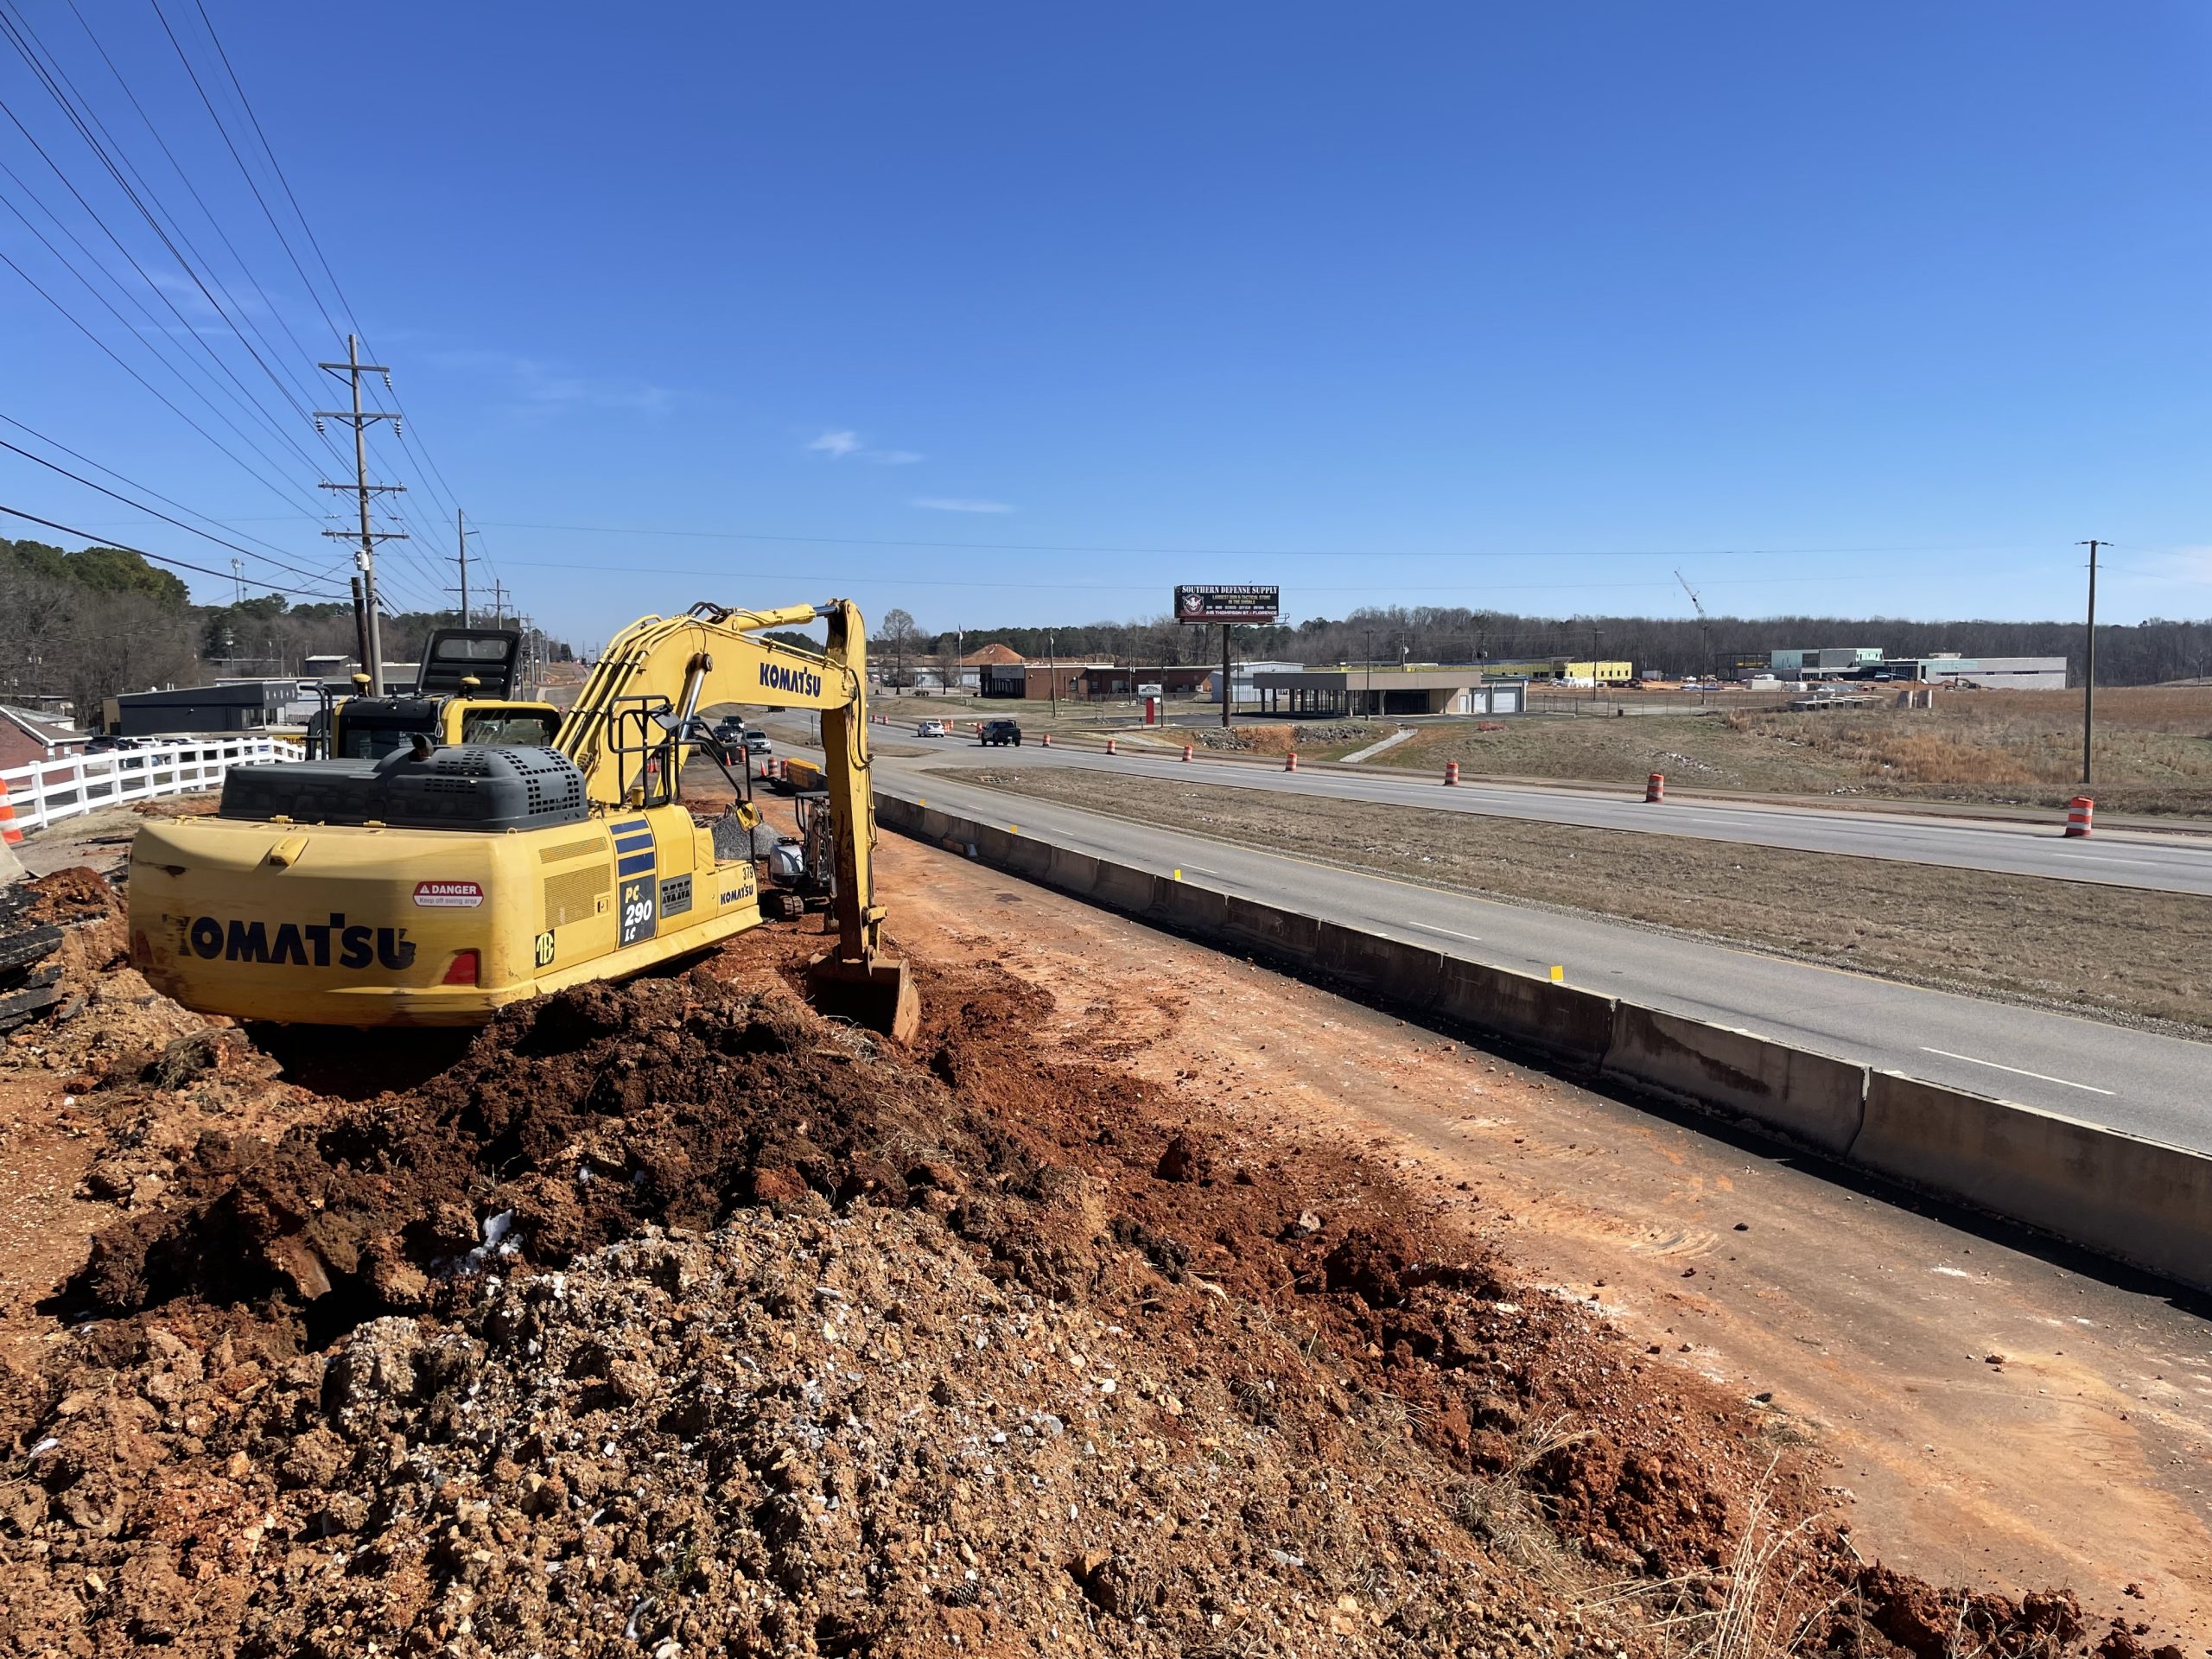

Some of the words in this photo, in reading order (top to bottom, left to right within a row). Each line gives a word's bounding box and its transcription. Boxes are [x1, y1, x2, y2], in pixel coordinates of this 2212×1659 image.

[760, 662, 821, 697] KOMATSU
[742, 866, 753, 880] 379
[432, 885, 477, 894] DANGER
[625, 884, 639, 904] PC
[721, 883, 753, 905] KOMATSU
[624, 899, 652, 927] 290
[624, 926, 637, 942] LC
